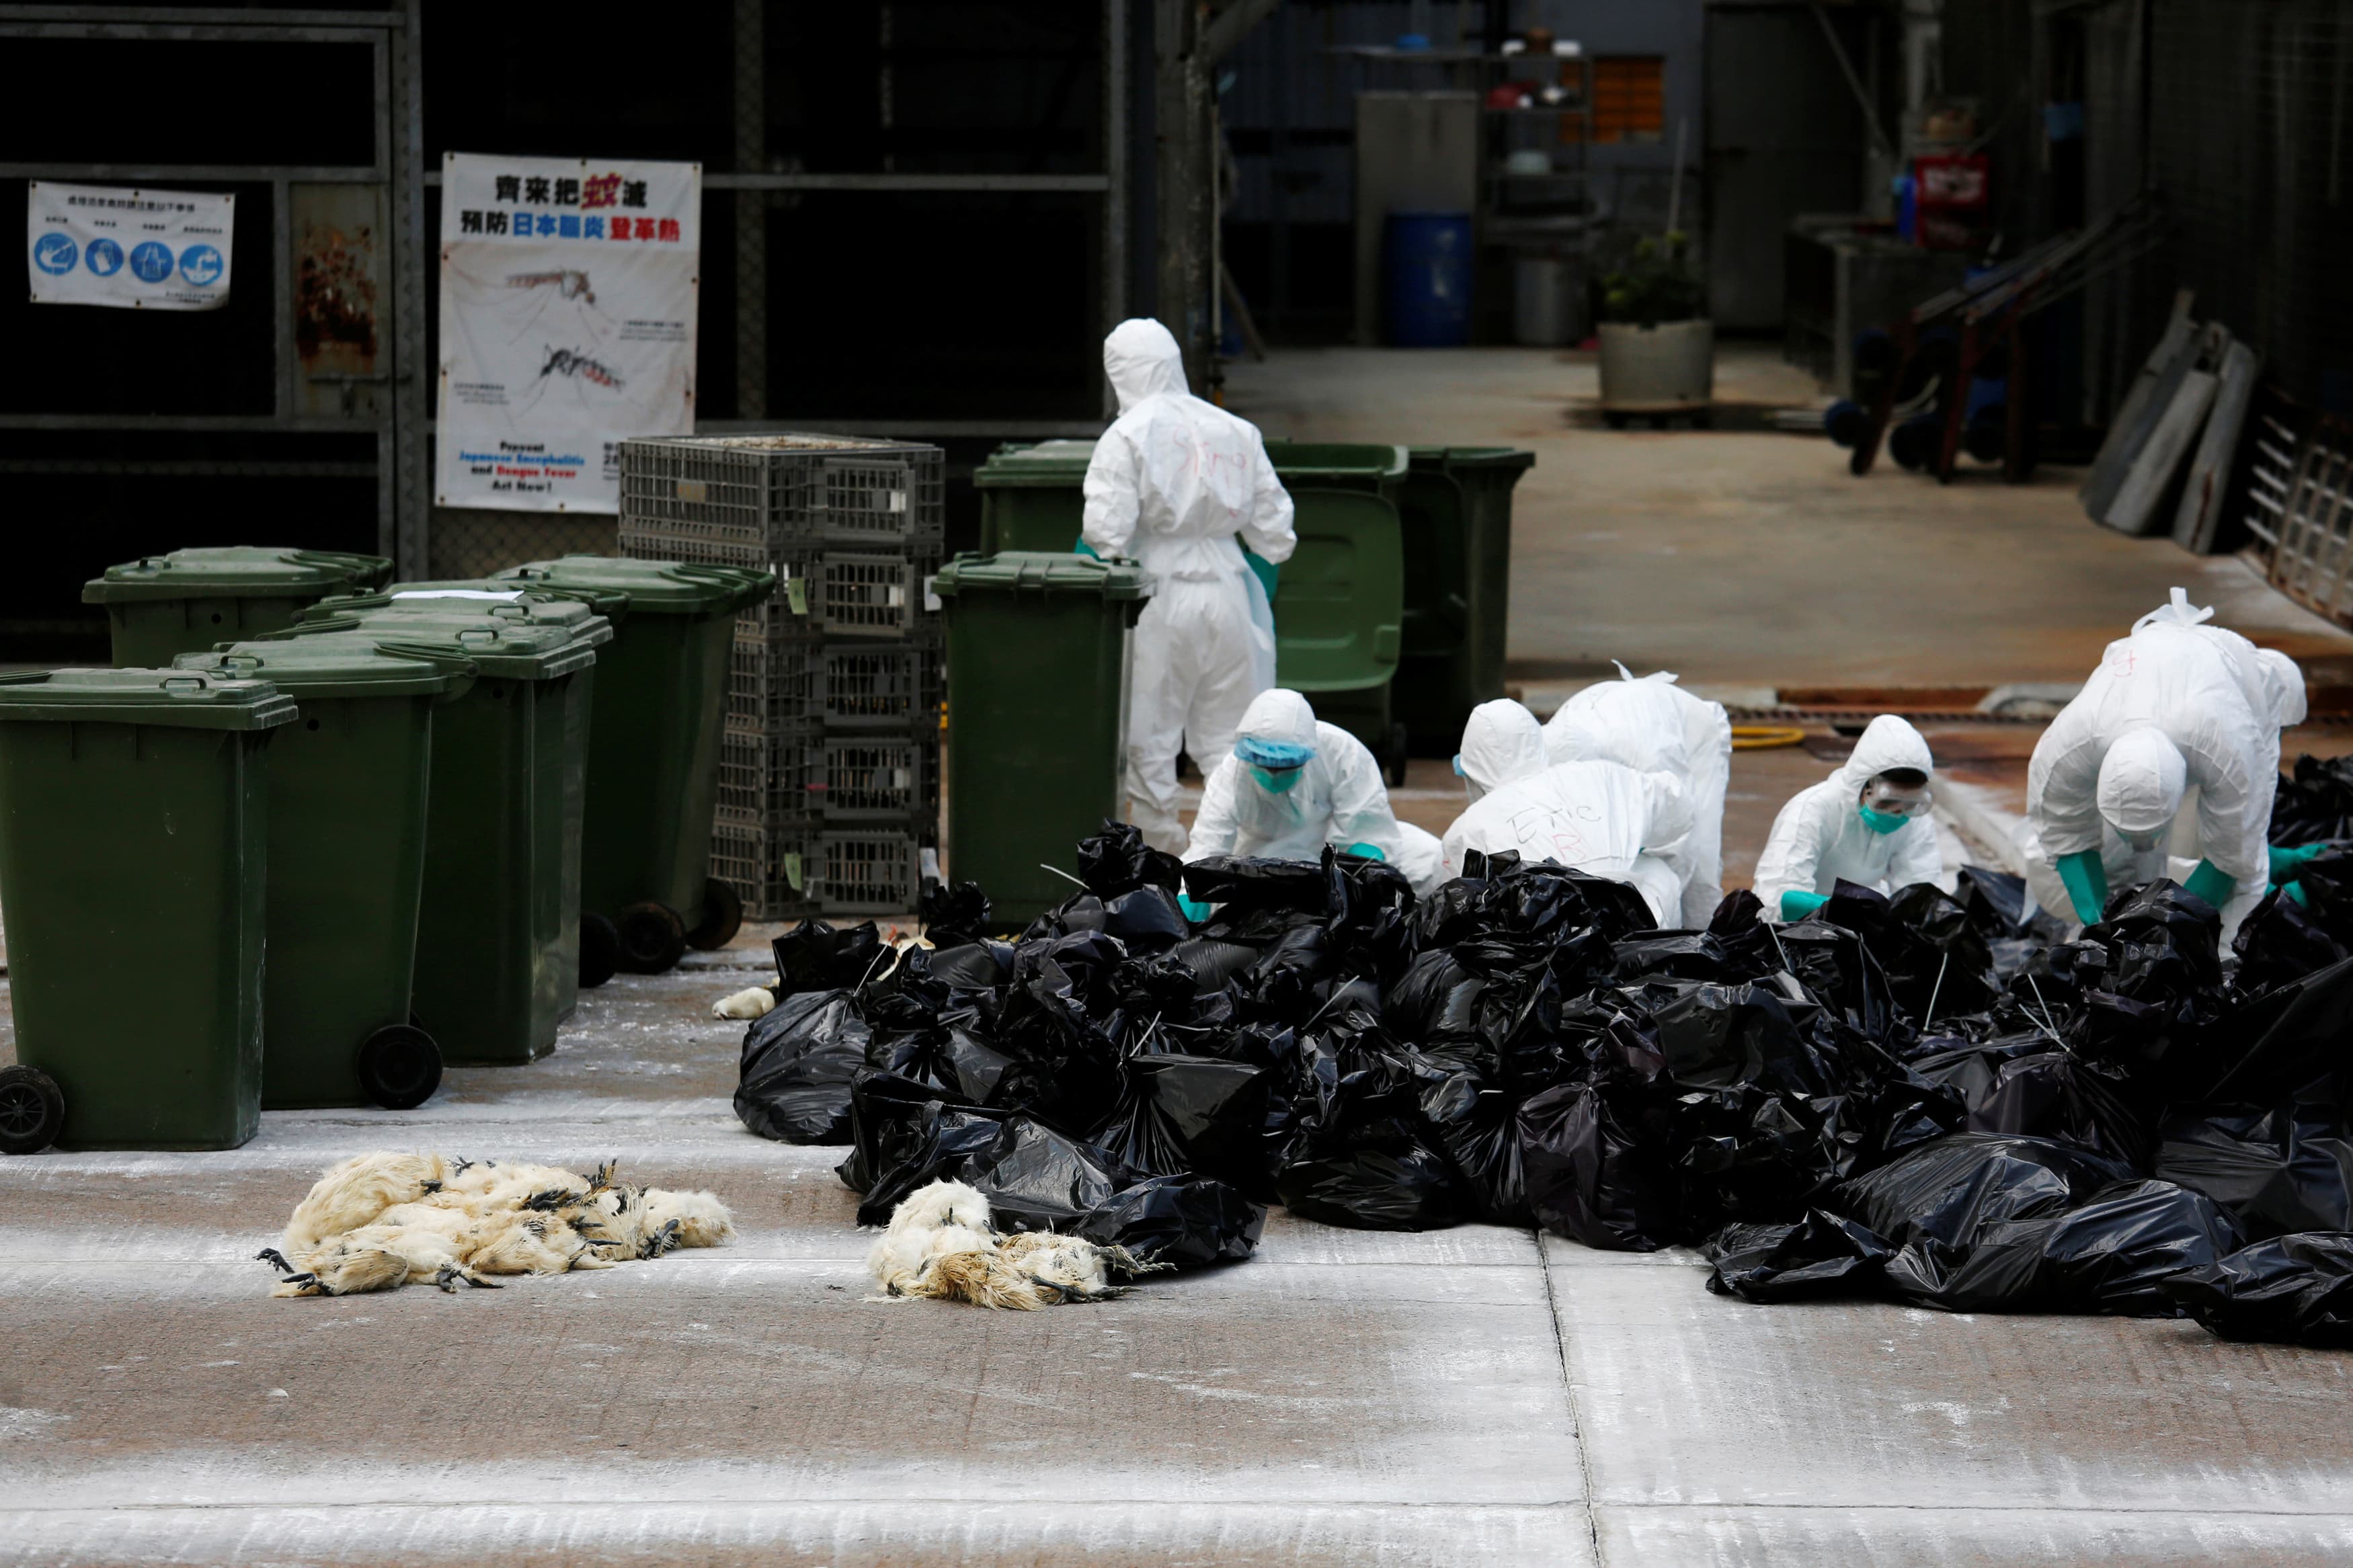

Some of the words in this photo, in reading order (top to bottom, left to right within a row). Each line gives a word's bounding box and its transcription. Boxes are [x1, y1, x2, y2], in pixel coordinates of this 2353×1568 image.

[500, 442, 545, 452] Prevent
[471, 464, 493, 475] and
[492, 480, 512, 491] Act
